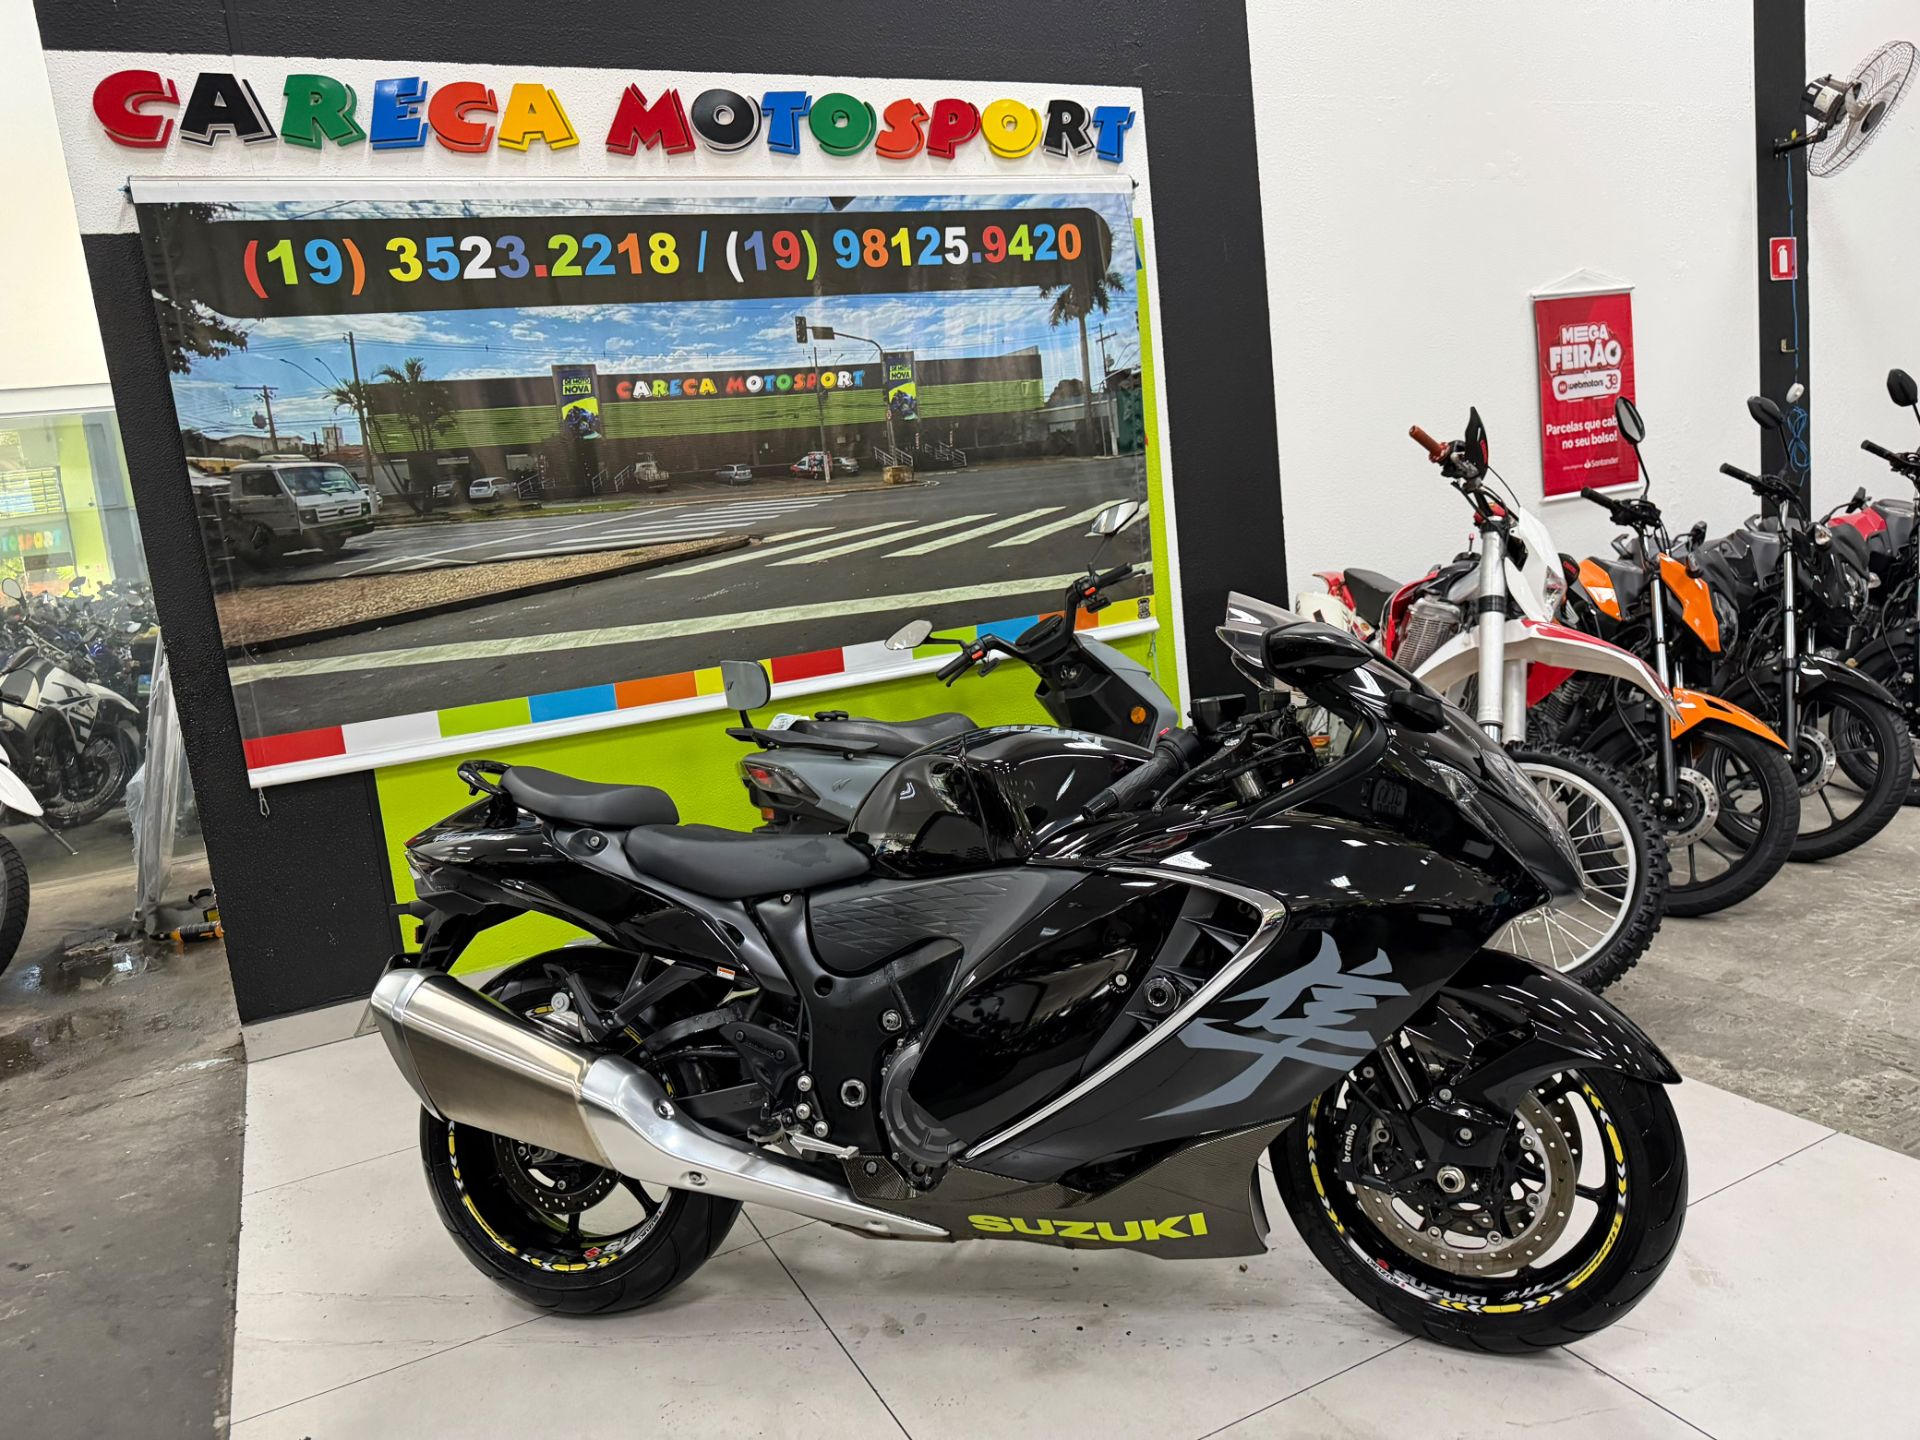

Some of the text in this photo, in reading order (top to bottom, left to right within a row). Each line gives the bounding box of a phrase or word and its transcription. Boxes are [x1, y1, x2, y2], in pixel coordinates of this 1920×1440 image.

[92, 69, 1136, 164] CARECA MOTOSPORT
[243, 238, 366, 299] (19)
[385, 231, 680, 283] 3523.2218
[726, 229, 818, 283] (19)
[832, 223, 1082, 270] 98125.9420
[1561, 324, 1609, 345] MEGA
[1549, 338, 1622, 373] FEIRÃO
[565, 385, 590, 394] NOVA
[616, 369, 866, 399] CARECA MOTOSPORT
[1568, 379, 1604, 390] webmotors
[1546, 415, 1618, 436] Parcelas que cab
[1562, 430, 1618, 449] no seu bolso!
[1591, 457, 1619, 468] Santander
[988, 724, 1102, 748] SUZUKI
[1342, 1123, 1358, 1163] brembo
[967, 1212, 1208, 1242] SUZUKI
[1366, 1257, 1401, 1285] SUZUKI
[1393, 1269, 1488, 1305] SUZUKI
